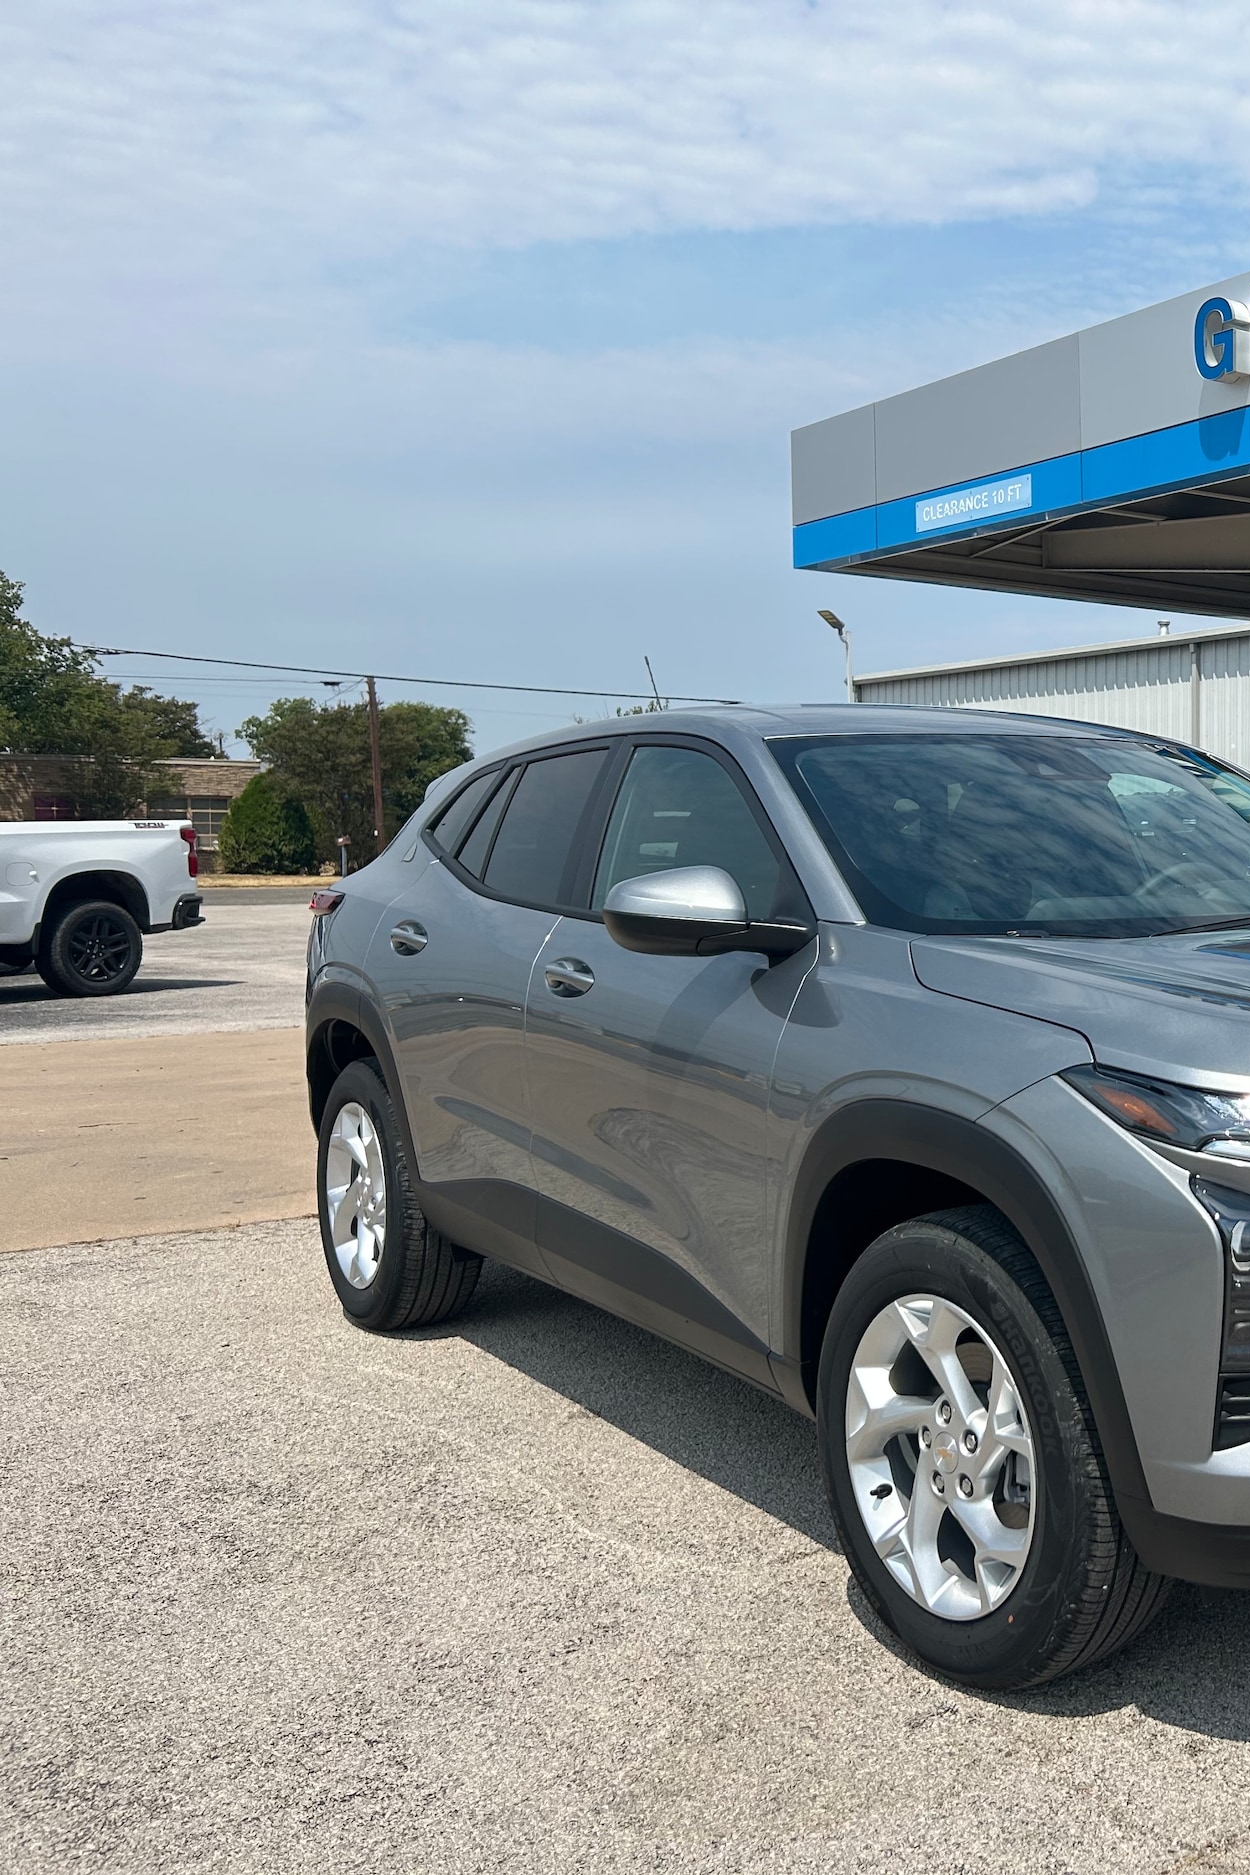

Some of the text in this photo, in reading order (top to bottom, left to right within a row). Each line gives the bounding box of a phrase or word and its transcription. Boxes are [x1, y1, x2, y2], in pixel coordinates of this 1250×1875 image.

[922, 483, 1022, 522] CLEARANCE 10 FT
